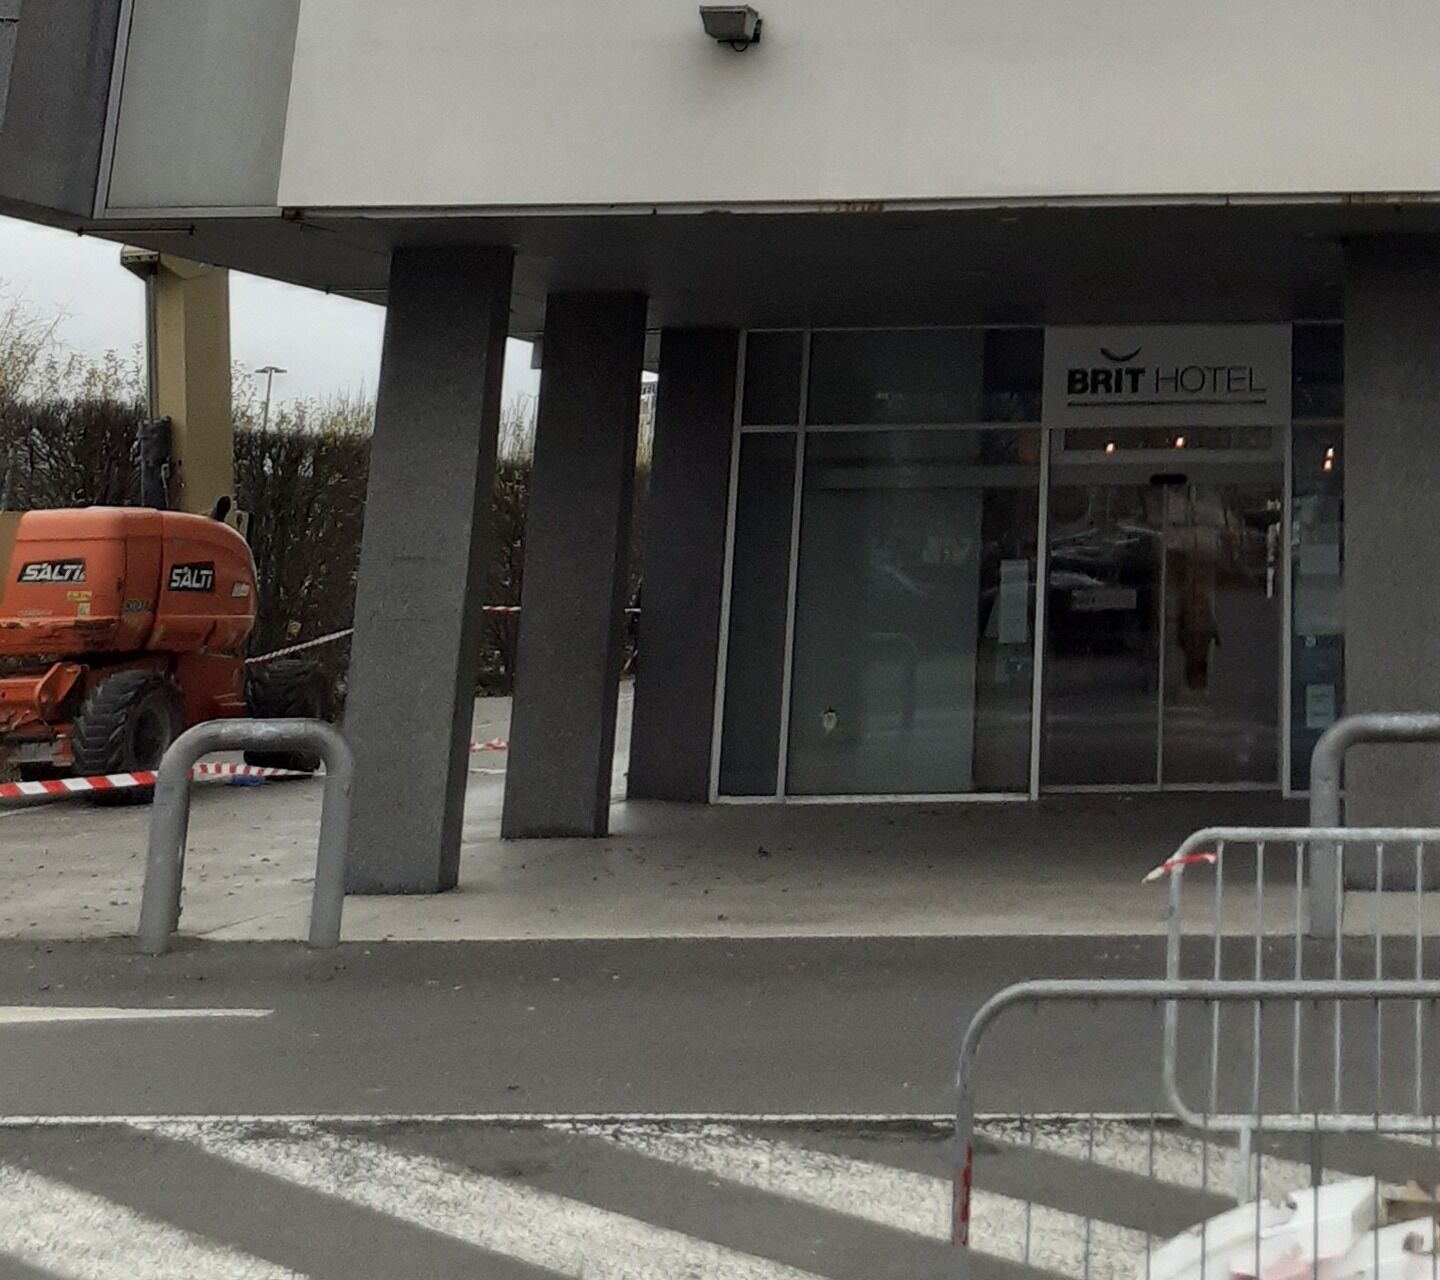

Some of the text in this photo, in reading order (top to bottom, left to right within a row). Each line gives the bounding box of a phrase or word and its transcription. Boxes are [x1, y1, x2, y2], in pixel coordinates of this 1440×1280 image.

[1066, 365, 1267, 395] BRIT HOTEL
[170, 566, 213, 589] SALTI
